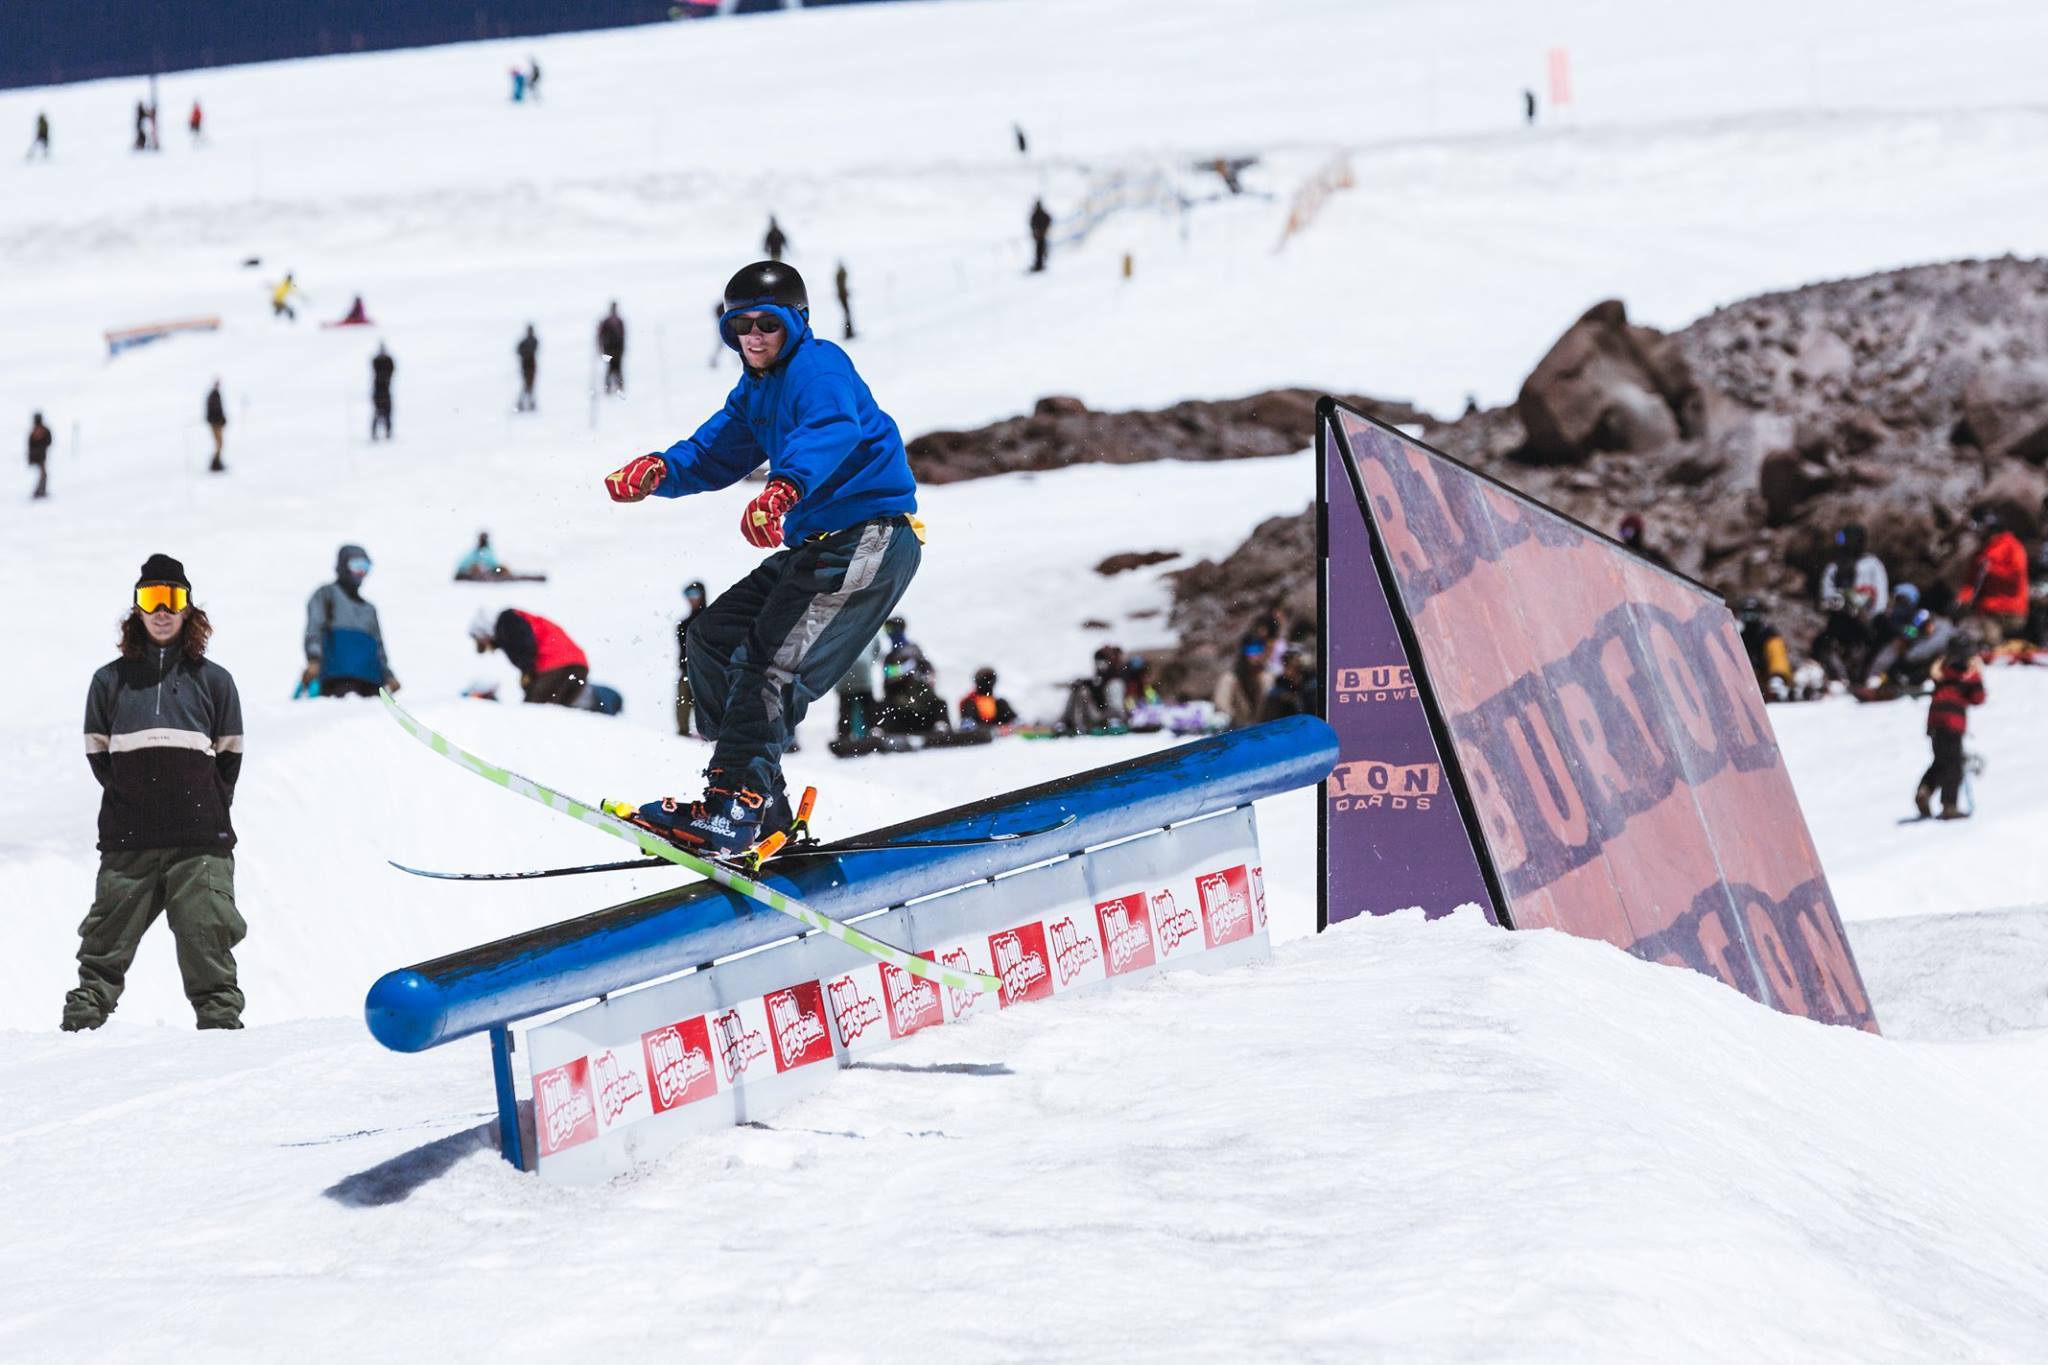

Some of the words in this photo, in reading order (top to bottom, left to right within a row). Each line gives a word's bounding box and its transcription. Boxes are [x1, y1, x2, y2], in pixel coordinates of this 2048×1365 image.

[1333, 766, 1429, 792] TON
[1457, 621, 1770, 873] BURTON
[690, 819, 736, 838] NORDICA
[1656, 901, 1867, 1017] TON
